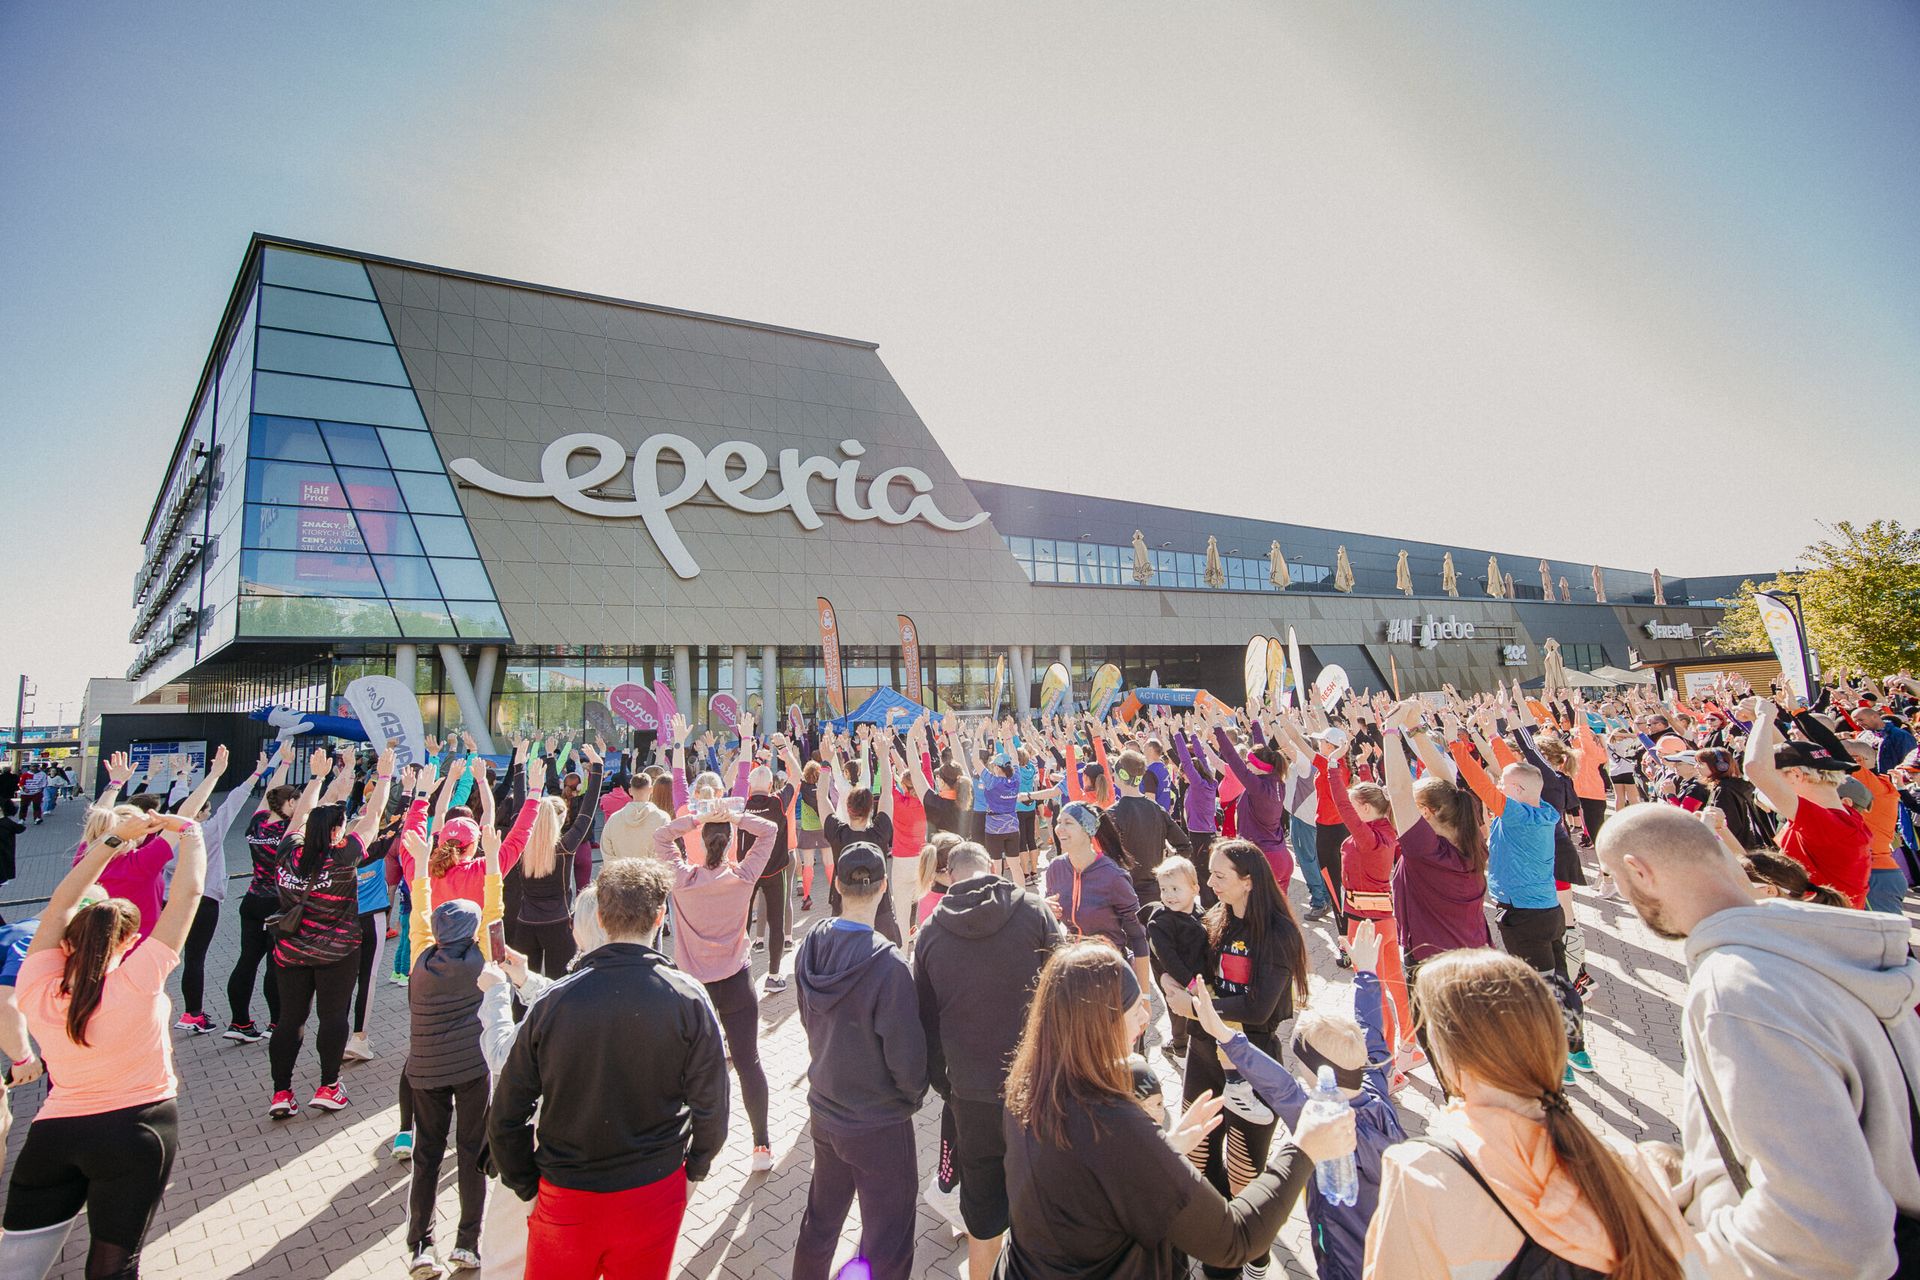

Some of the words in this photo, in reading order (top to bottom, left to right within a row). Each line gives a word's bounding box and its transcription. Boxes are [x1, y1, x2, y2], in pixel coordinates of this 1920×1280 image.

[304, 484, 330, 495] Half
[303, 493, 329, 503] Price
[449, 433, 991, 579] eperia
[302, 537, 327, 545] CENY,
[1427, 614, 1475, 640] hebe
[1656, 624, 1685, 639] FRESH
[1139, 691, 1169, 701] ACTIVE
[1173, 693, 1191, 702] LIFE
[1319, 681, 1337, 703] RESH
